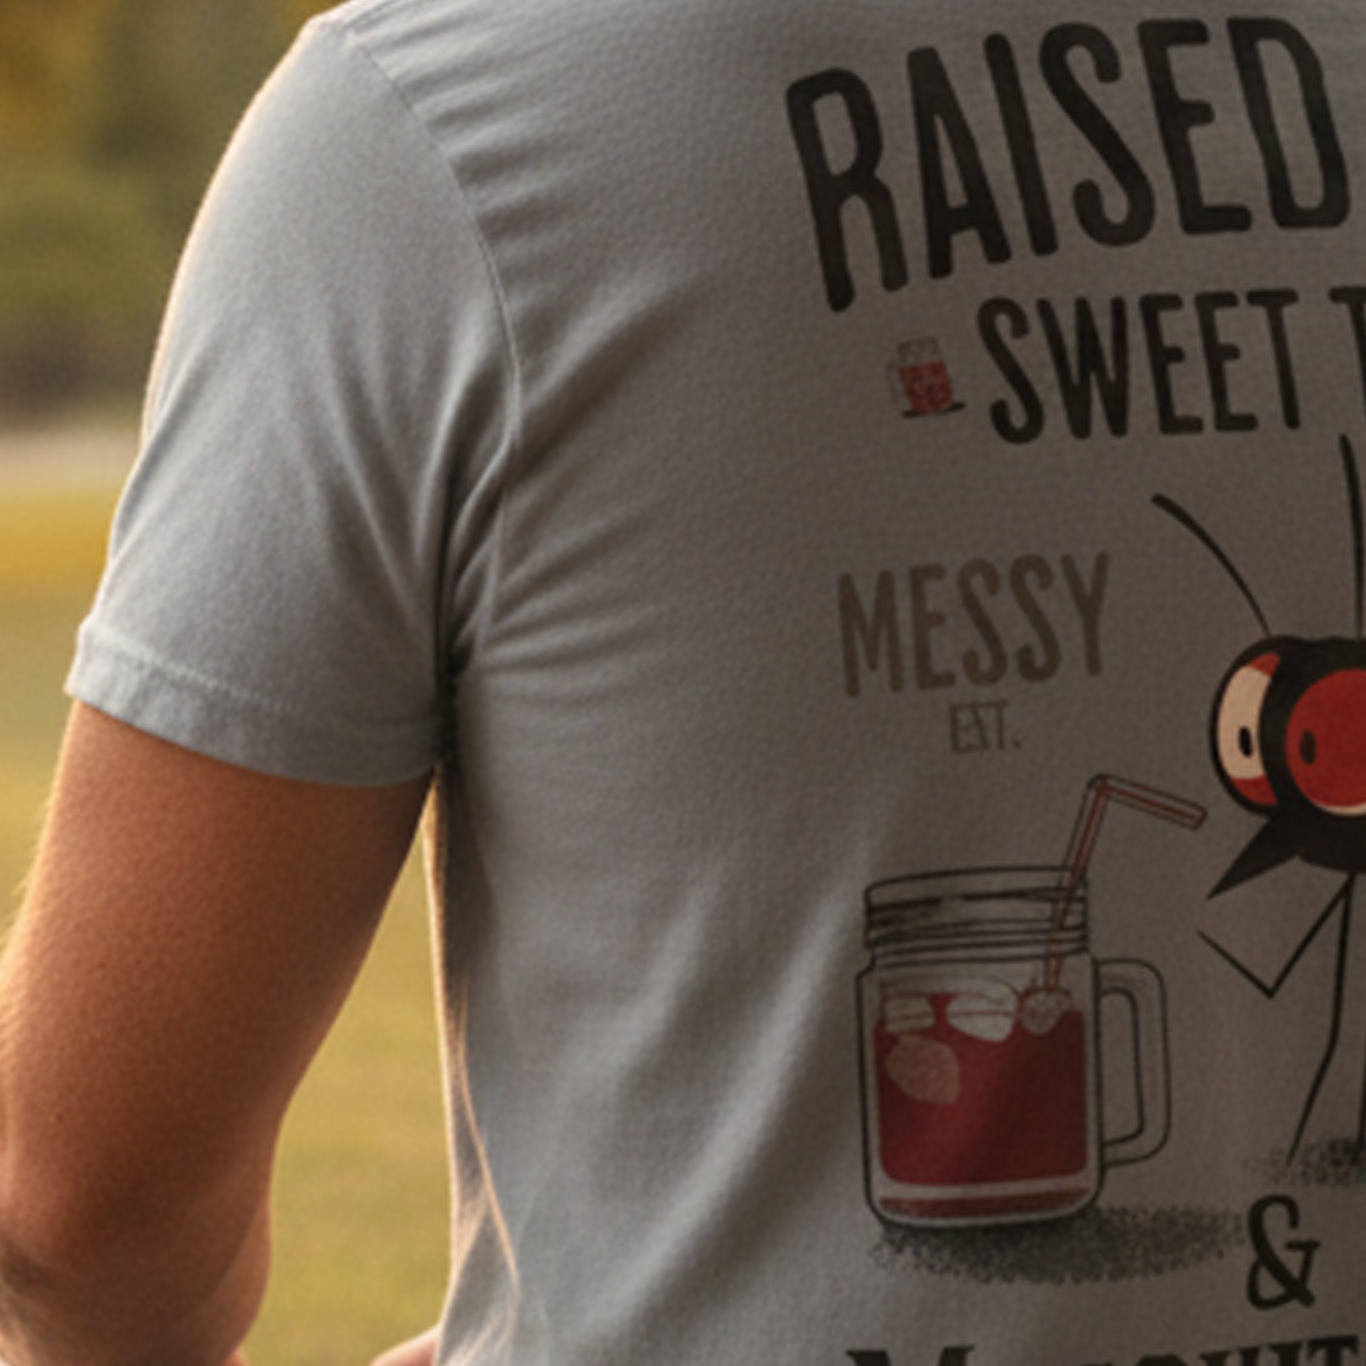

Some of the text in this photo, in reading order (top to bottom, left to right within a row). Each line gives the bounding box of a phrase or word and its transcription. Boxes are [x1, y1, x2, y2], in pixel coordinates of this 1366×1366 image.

[785, 16, 1352, 313] RAISED
[977, 288, 1301, 445] SWEET
[838, 551, 1110, 698] MESSY
[948, 699, 1023, 755] EST.
[1246, 1194, 1321, 1310] &
